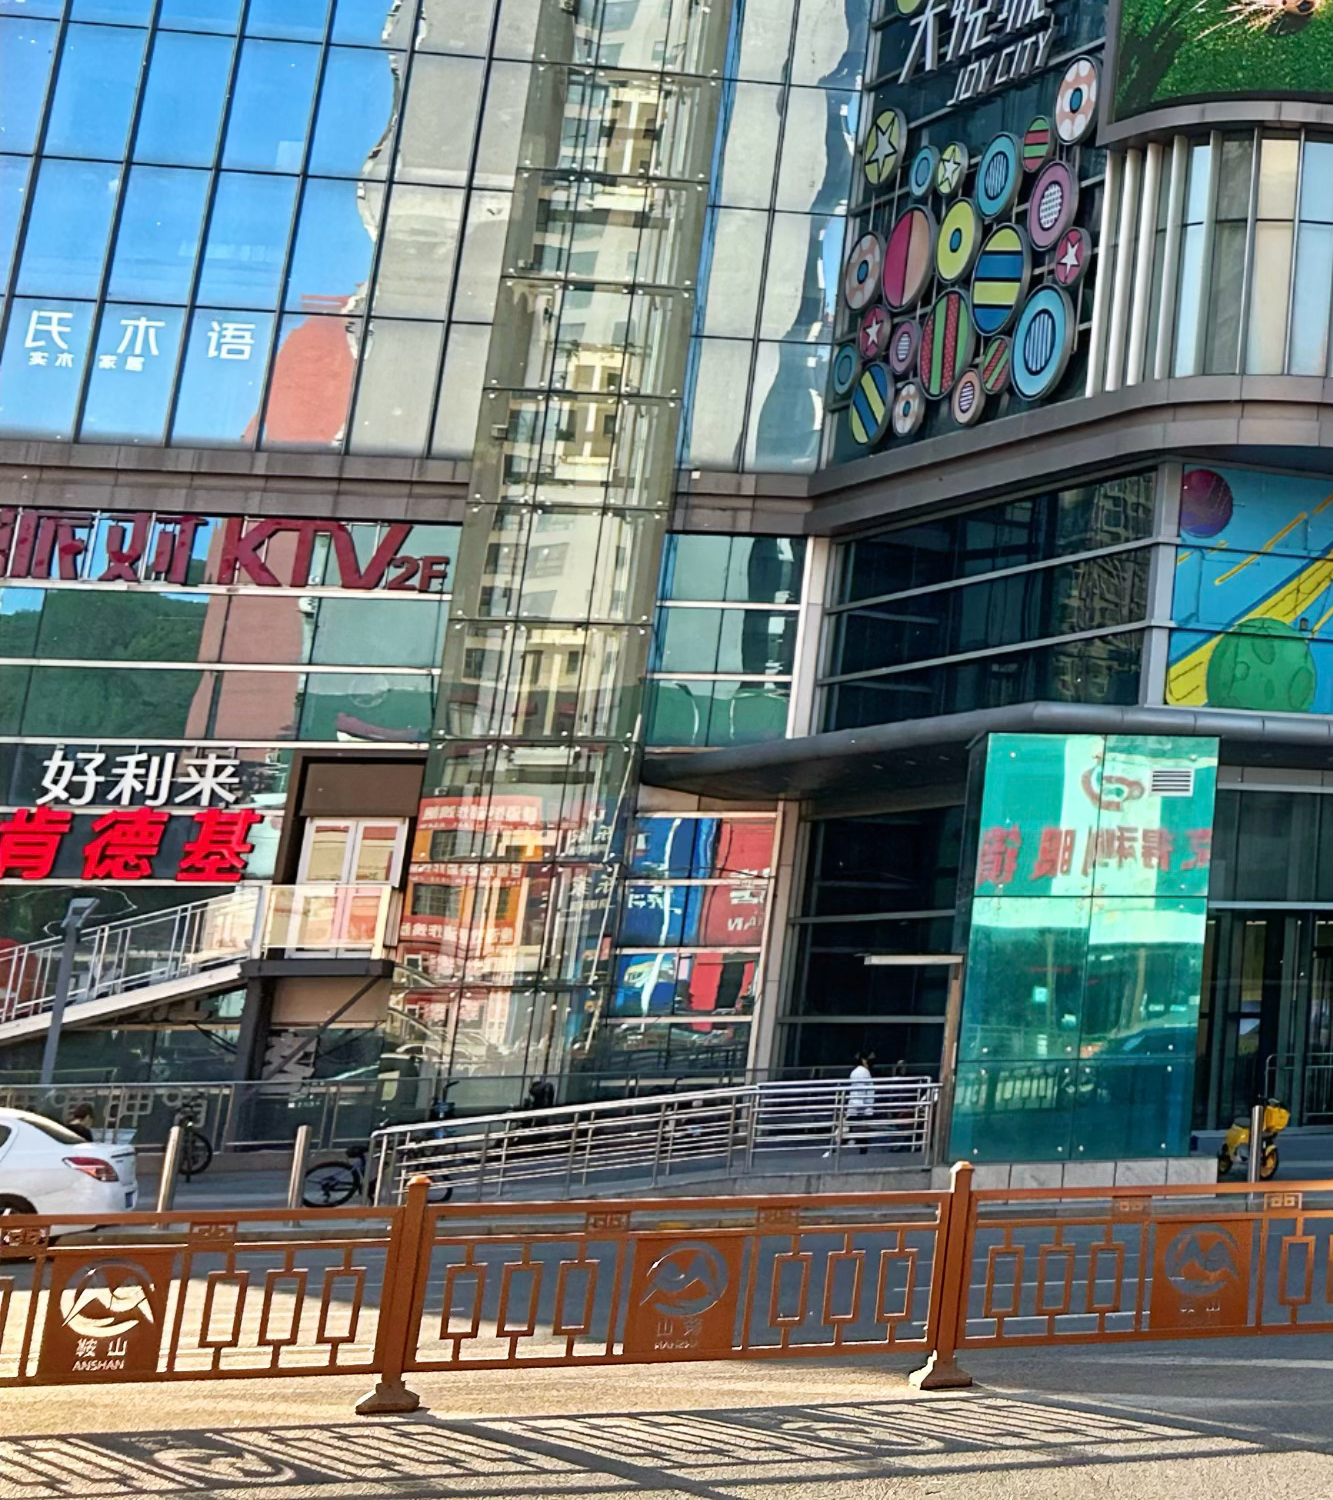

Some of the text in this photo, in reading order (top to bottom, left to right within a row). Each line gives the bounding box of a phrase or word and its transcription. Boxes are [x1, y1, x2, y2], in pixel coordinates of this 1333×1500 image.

[946, 26, 1056, 107] JOY CITY
[386, 555, 451, 593] 2F
[36, 749, 241, 807] 好利来
[0, 805, 263, 882] 肯德基
[72, 1359, 125, 1371] ANSHAN
